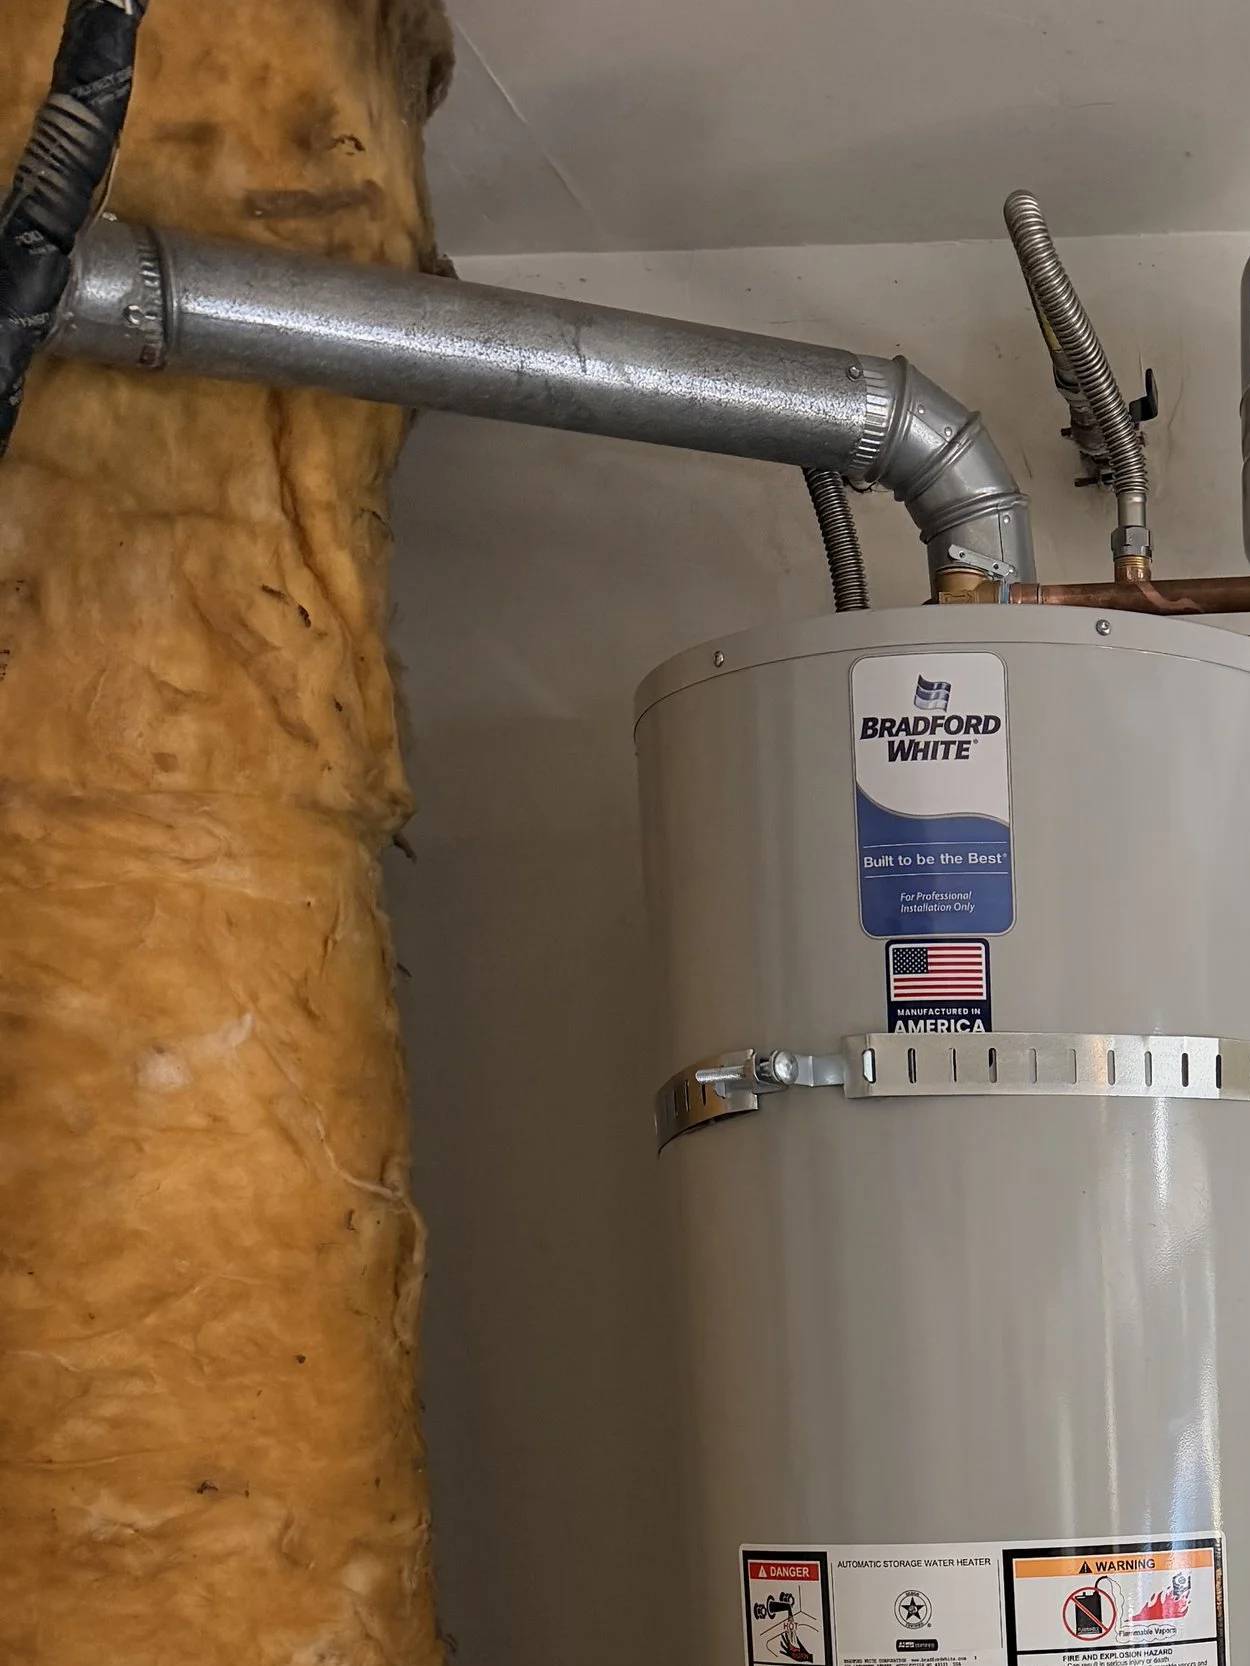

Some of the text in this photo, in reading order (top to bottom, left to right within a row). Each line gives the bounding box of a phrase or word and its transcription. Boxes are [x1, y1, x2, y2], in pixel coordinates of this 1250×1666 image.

[860, 715, 1001, 740] BRADFORD
[863, 856, 894, 868] Built
[898, 855, 912, 866] to
[916, 853, 935, 865] be
[940, 852, 963, 865] the
[900, 891, 972, 902] For Professional
[900, 902, 976, 913] Installation Only
[897, 1008, 969, 1016] MANUFACTURED
[894, 1018, 986, 1033] AMERICA
[837, 1558, 991, 1568] AUTOMATIC STORAGE WATER HEATER
[1095, 1559, 1155, 1572] WARNING
[770, 1566, 810, 1578] DANGER
[783, 1622, 798, 1631] HOT
[1099, 1651, 1142, 1660] EXPLOSION
[1143, 1648, 1173, 1657] HAZARD
[1129, 1658, 1145, 1666] injury
[1153, 1656, 1170, 1664] death
